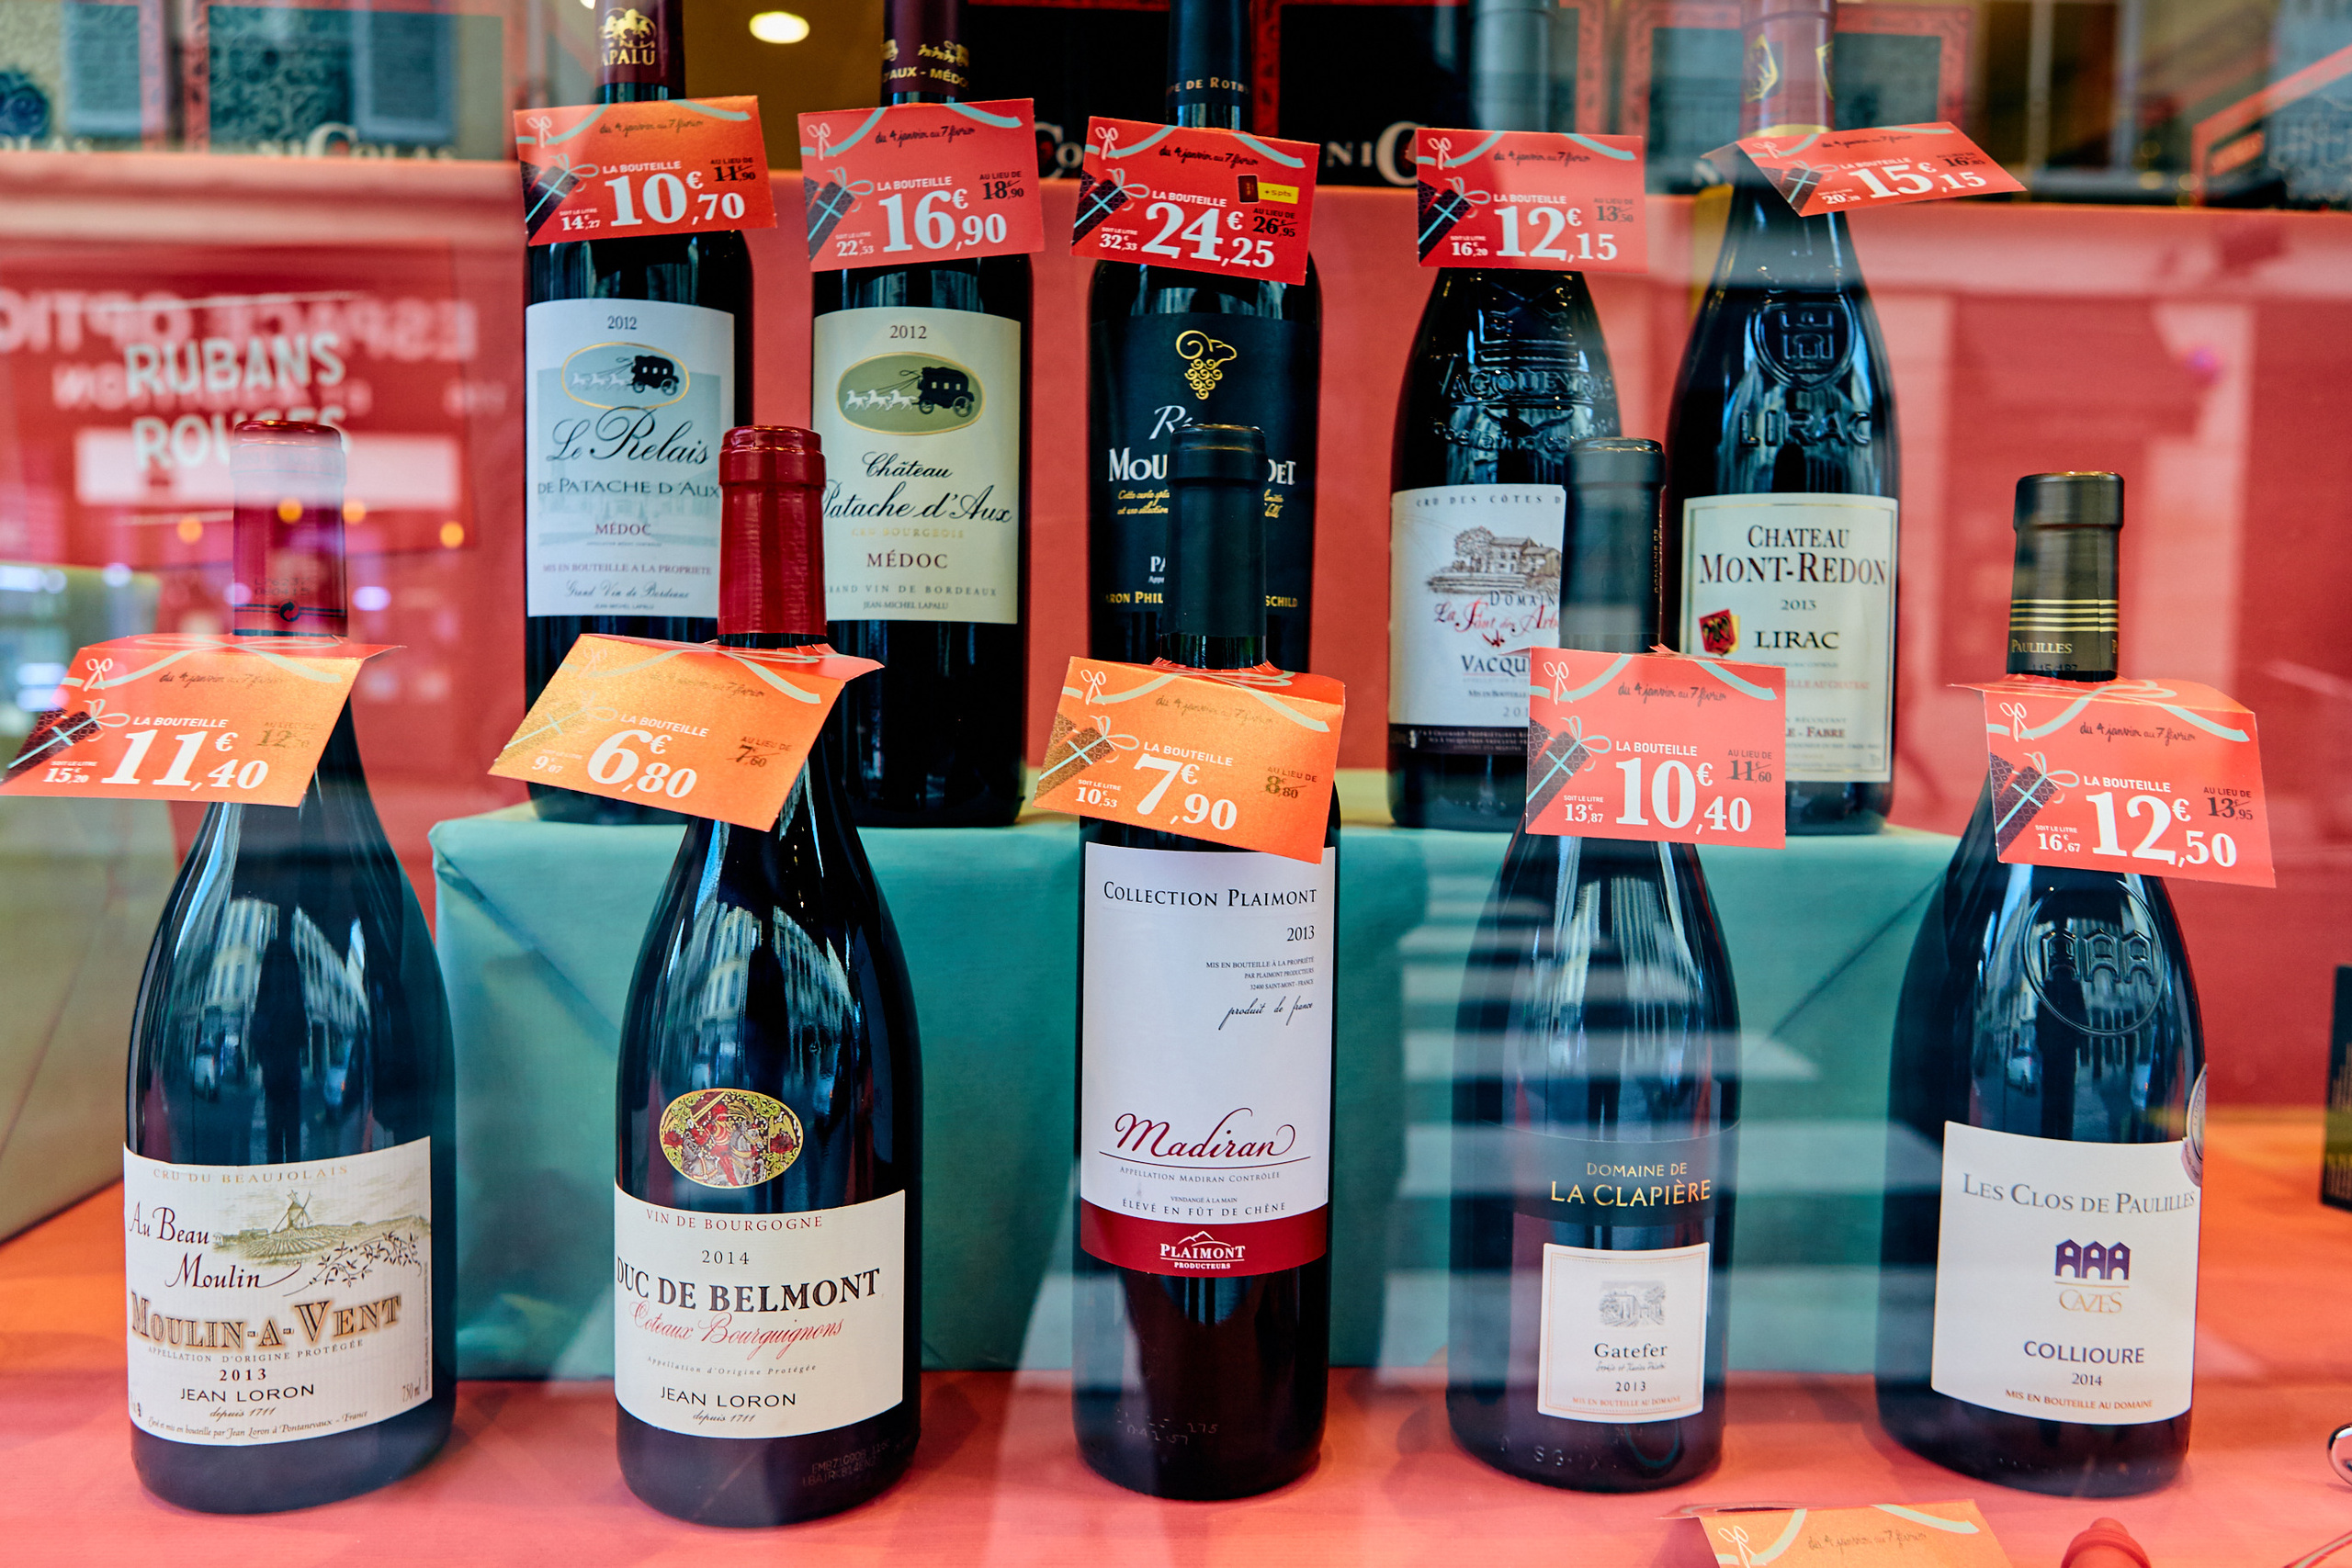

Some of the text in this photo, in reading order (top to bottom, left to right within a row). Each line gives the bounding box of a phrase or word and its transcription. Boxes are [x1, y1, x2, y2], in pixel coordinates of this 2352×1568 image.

[603, 160, 682, 174] LA BOUTEILLE
[877, 175, 952, 191] LA BOUTEILLE
[608, 316, 638, 330] 2012
[890, 325, 927, 339] 2012
[124, 332, 346, 399] RUBANS
[546, 405, 709, 465] Le Relais
[862, 451, 953, 478] Château
[1108, 447, 1168, 482] MOU
[537, 482, 554, 494] DE
[560, 478, 650, 494] PATACHE
[912, 485, 1012, 523] d'Aux
[595, 522, 651, 536] MÉDOC
[1748, 525, 1850, 548] CHATEAU
[866, 550, 948, 570] MÉDOC
[1700, 552, 1886, 585] MONT-REDON
[828, 585, 997, 596] RAND VIN DE BORDEAUX
[1489, 590, 1555, 606] DOMAIN
[1781, 599, 1816, 611] 2013
[1754, 631, 1838, 649] LIRAC
[2011, 638, 2073, 654] PAULILLES
[1461, 654, 1530, 677] VACQU
[1690, 687, 1698, 698] 7
[1144, 741, 1233, 767] LA BOUTEILLE
[1616, 740, 1698, 756] LA BOUTEILLE
[2084, 775, 2171, 794] LA BOUTEILLE
[2203, 786, 2251, 798] AU LIEU DE
[1103, 881, 1317, 908] COLLECTION PLAIMONT
[1286, 925, 1315, 942] 2013
[1232, 960, 1271, 968] BOUTEILLE
[1256, 970, 1283, 978] PLAIMONT
[1283, 967, 1314, 976] PRODUCTEURS
[1265, 981, 1295, 990] SAINT-MONT
[1218, 995, 1313, 1031] produit de france
[1114, 1107, 1295, 1158] Madiran
[153, 1165, 347, 1184] CRU DU BEAUJOLAIS
[1119, 1166, 1280, 1183] APPELLATION MADIRAN CONTRÔLÉE
[1587, 1162, 1687, 1178] DOMAINE DE
[1551, 1179, 1711, 1207] LA CLAPIÈRE
[1962, 1173, 2196, 1213] LES CLOS DE PAULILLES
[1122, 1198, 1286, 1216] ÉLEVÉ EN FÛT DE CHÊNE
[129, 1201, 210, 1245] Au Beau
[646, 1209, 823, 1232] VIN DE BOURGOGNE
[701, 1250, 750, 1265] 2014
[1159, 1243, 1246, 1259] PLAIMONT
[164, 1251, 302, 1289] Moulin
[616, 1256, 880, 1314] DUC DE BELMONT
[2059, 1289, 2122, 1314] CAZES
[130, 1291, 401, 1349] MOULIN-A-VENT
[628, 1301, 844, 1361] Coteaux Bourguignons
[148, 1338, 364, 1364] APPELLATION D'ORIGINE PROTÉGÉE
[1594, 1342, 1668, 1359] Gatefer
[2023, 1340, 2145, 1364] COLLIOURE
[220, 1368, 266, 1382] 2013
[647, 1356, 817, 1377] Appellation d'Origine Protégée
[1615, 1382, 1646, 1392] 2013
[2071, 1372, 2103, 1387] 2014
[181, 1383, 314, 1403] JEAN LORON
[661, 1386, 797, 1408] JEAN LORON
[2006, 1389, 2153, 1410] MIS EN BOUTEILLE AU DOMAINE
[209, 1405, 277, 1422] depuis 1711
[693, 1409, 756, 1425] depuis 1711
